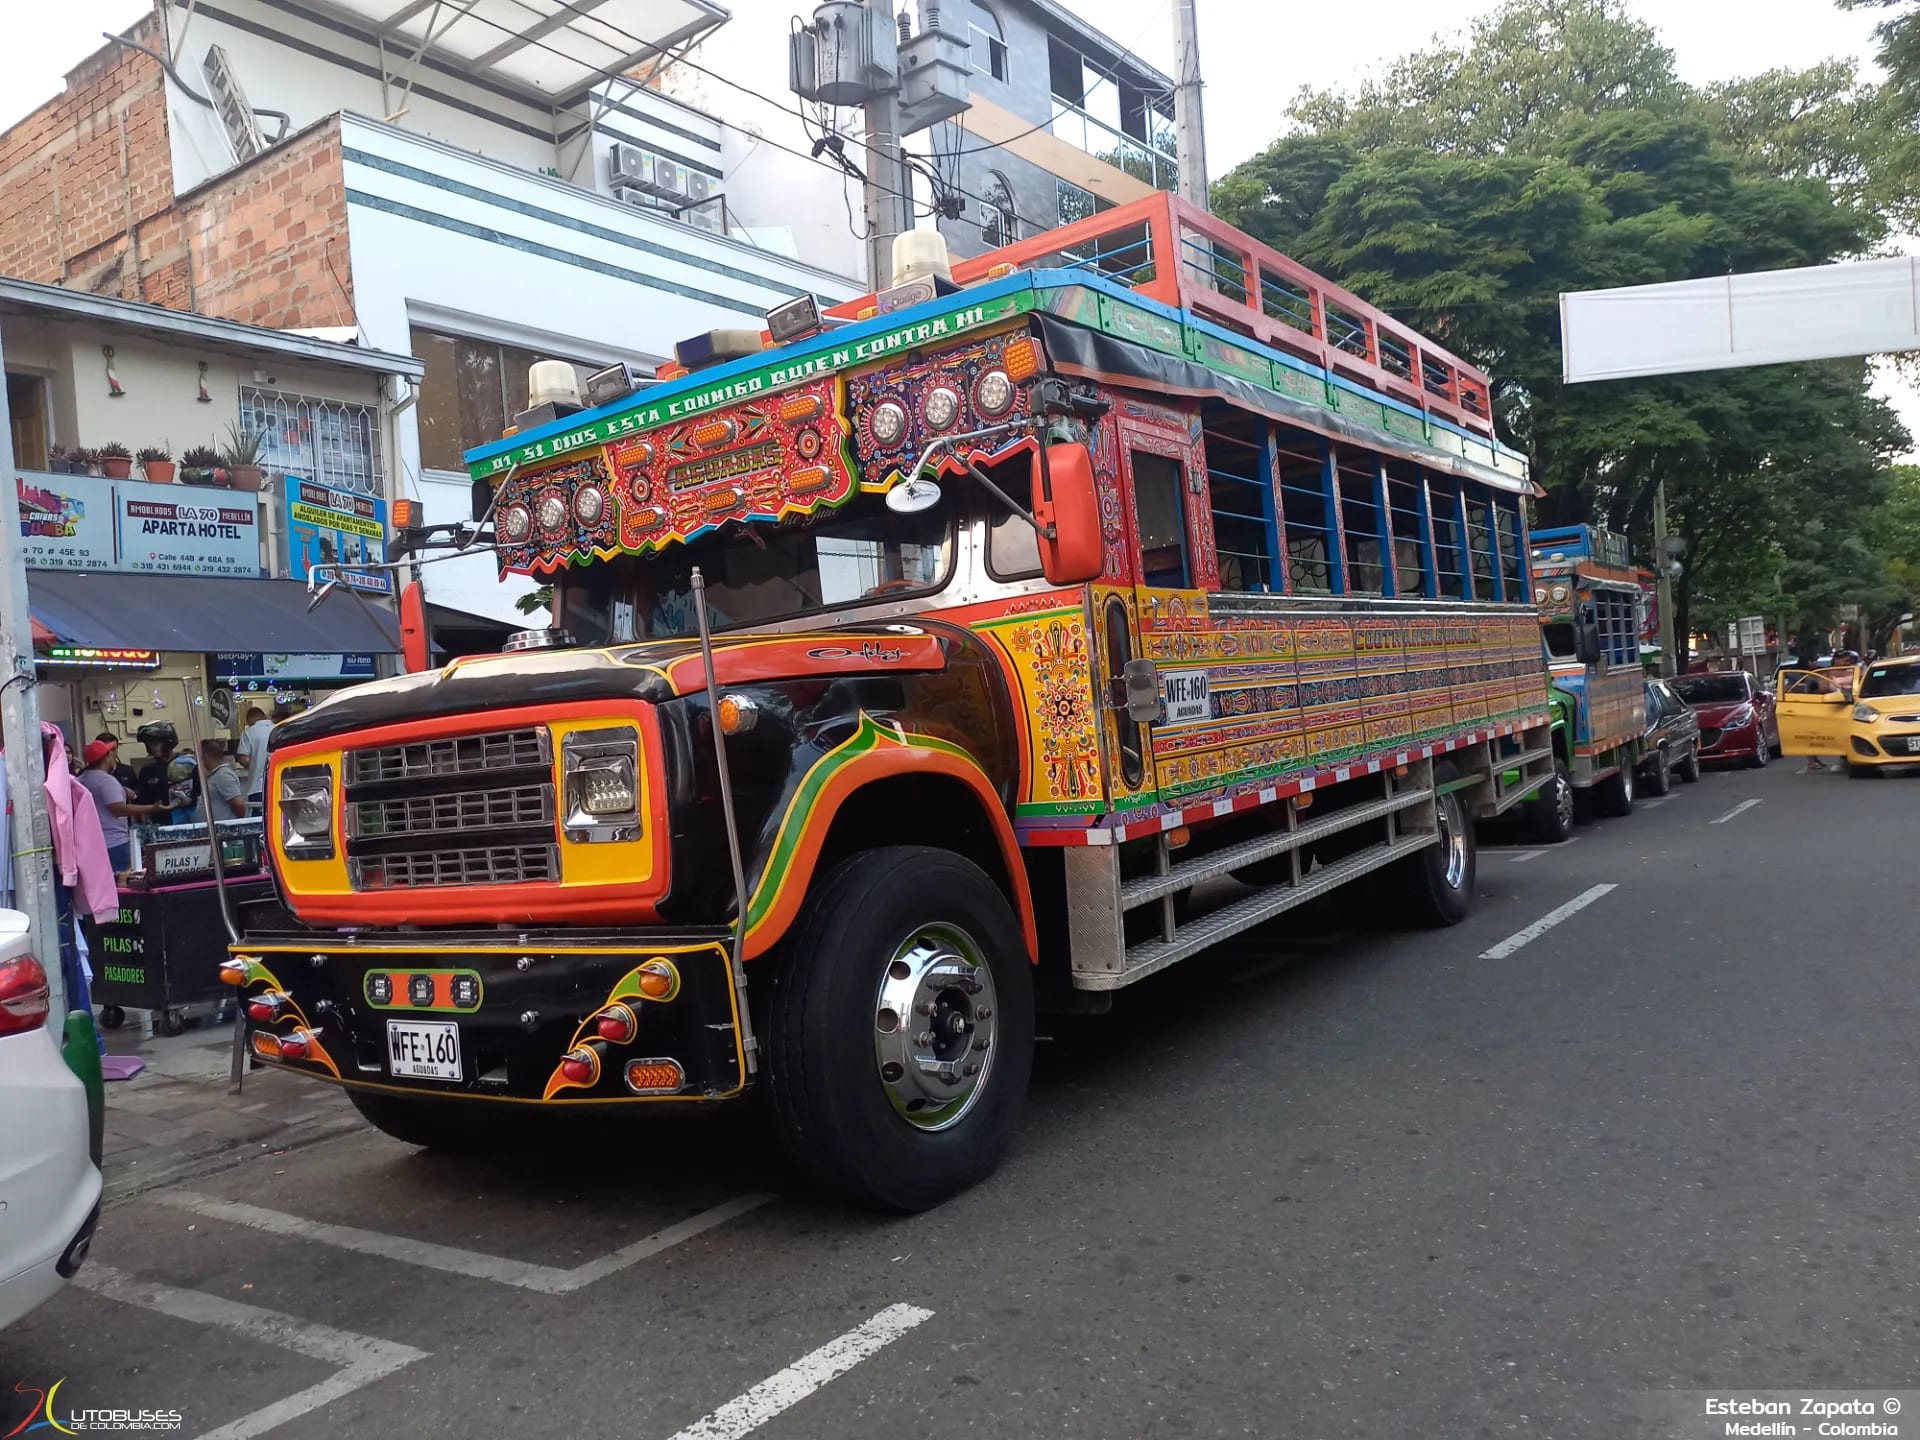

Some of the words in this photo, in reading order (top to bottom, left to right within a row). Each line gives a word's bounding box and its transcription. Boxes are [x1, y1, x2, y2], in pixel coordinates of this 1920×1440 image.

[551, 427, 598, 452] DIOS
[606, 408, 660, 435] ESTA
[668, 375, 762, 416] CONMIGO
[770, 350, 850, 386] QUIEN
[855, 317, 949, 359] CONTRA
[955, 307, 984, 329] MI
[330, 492, 342, 507] LA
[342, 495, 354, 511] 70
[179, 506, 198, 520] LA
[199, 508, 218, 520] 70
[300, 505, 327, 517] ALQUILER
[198, 523, 242, 540] HOTEL
[31, 546, 43, 555] 70
[59, 548, 76, 556] 45E
[79, 549, 90, 557] 93
[158, 553, 177, 561] Calle
[67, 559, 83, 567] 432
[165, 856, 191, 869] PILAS
[193, 855, 200, 866] Y
[103, 937, 132, 953] PILAS
[104, 966, 145, 984] PASADORES
